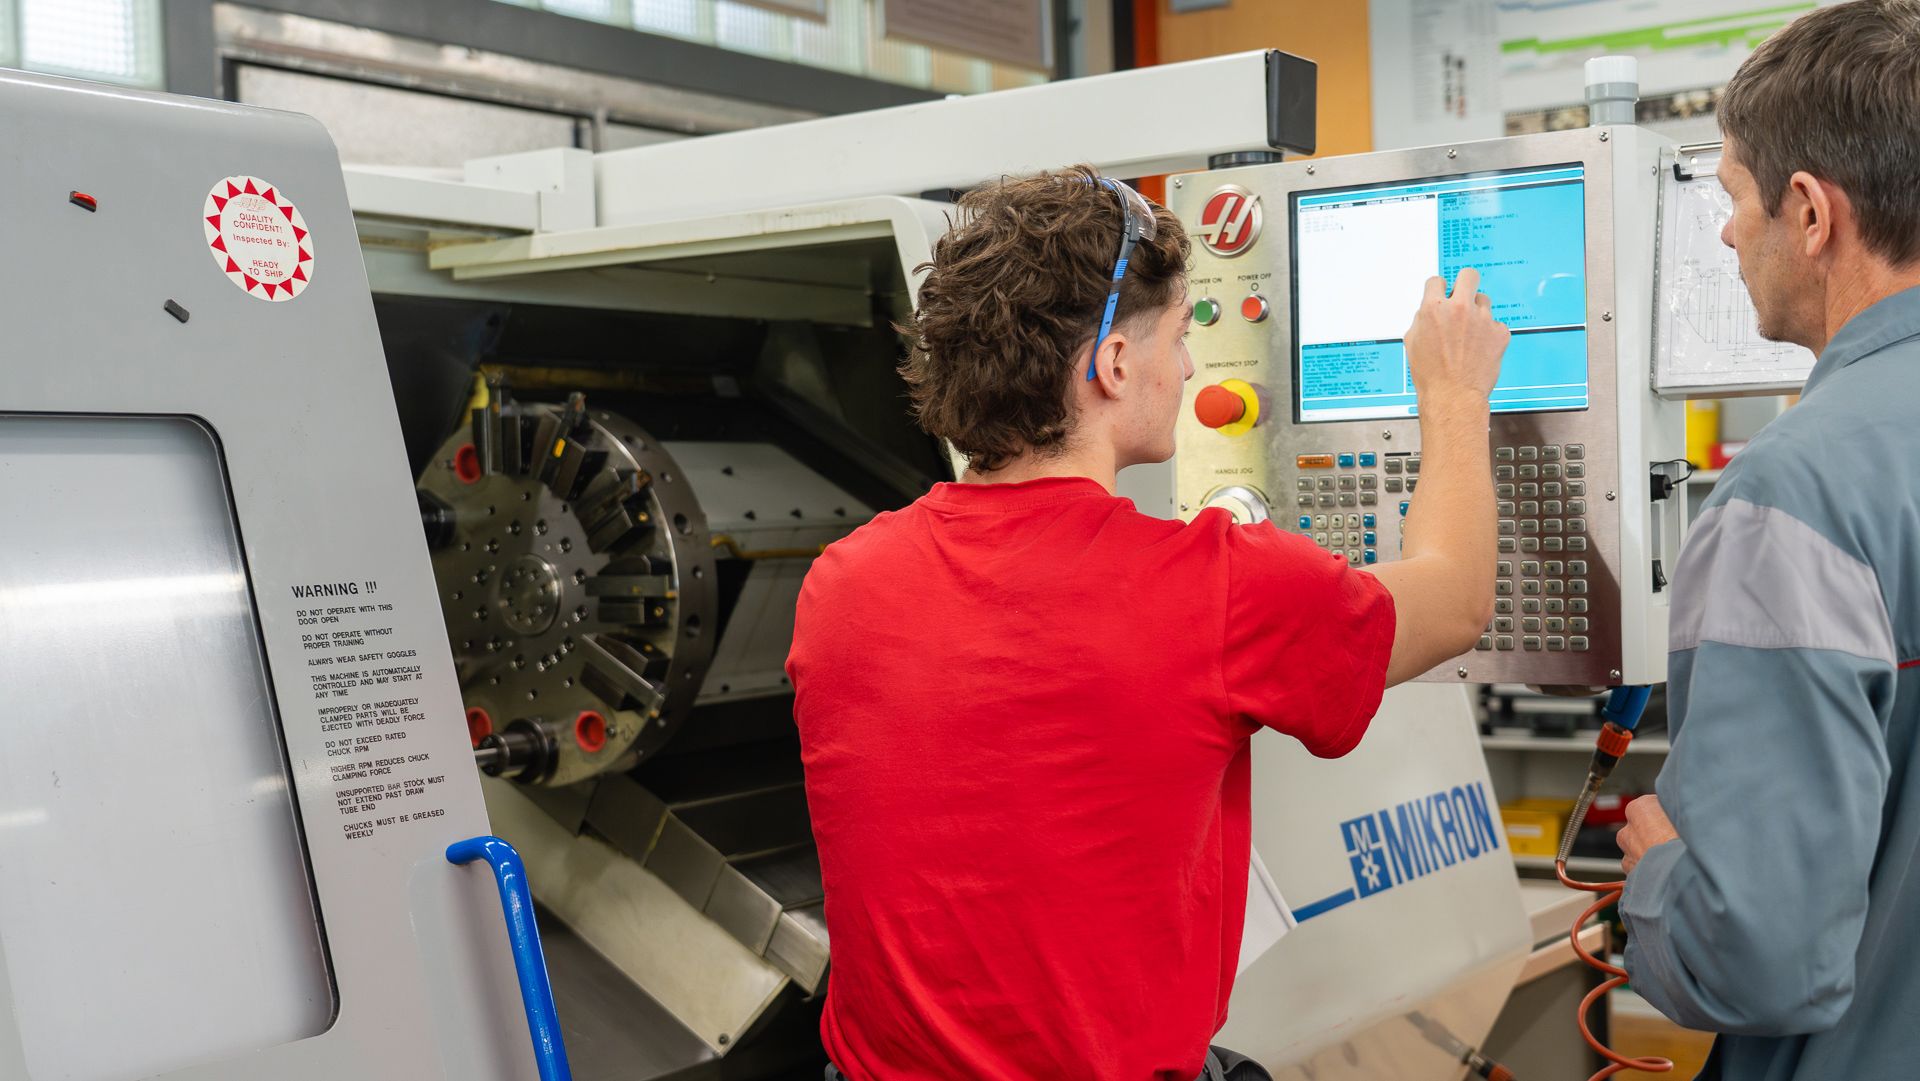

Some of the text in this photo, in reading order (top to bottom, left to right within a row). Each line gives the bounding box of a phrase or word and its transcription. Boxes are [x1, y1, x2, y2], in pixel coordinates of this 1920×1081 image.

[240, 213, 273, 223] QUALITY
[234, 221, 283, 233] CONFIDENT!
[233, 234, 273, 245] Inspected
[253, 260, 279, 269] READY
[249, 268, 260, 276] TO
[1206, 361, 1242, 369] EMERGENCY
[292, 581, 377, 598] WARNING !!!
[297, 610, 307, 618] DO
[327, 607, 356, 616] OPERATE
[359, 605, 376, 613] WITH
[298, 616, 339, 626] DOOR OPEN
[315, 633, 329, 641] NOT
[332, 631, 361, 640] OPERATE
[364, 628, 393, 637] WITHOUT
[304, 639, 365, 650] PROPER TRAINING
[308, 650, 417, 667] ALWAYS WEAR SAFETY GOGGLES
[311, 675, 327, 683] THIS
[330, 672, 359, 681] MACHINE
[372, 665, 422, 677] AUTOMATICALLY
[313, 680, 357, 691] CONTROLLED
[393, 674, 412, 682] START
[332, 689, 349, 697] TIME
[318, 705, 358, 716] IMPROPERLY
[375, 698, 419, 709] INADEQUATELY
[320, 714, 353, 724] CLAMPED
[356, 711, 378, 720] PARTS
[381, 709, 397, 717] WILL
[322, 713, 426, 732] EJECTED WITH DEADLY FORCE
[325, 732, 407, 749] DO NOT EXCEED RATED
[328, 748, 352, 757] CHUCK
[331, 754, 430, 773] HIGHER RPM REDUCES CHUCK
[333, 767, 392, 782] CLAMPING FORCE
[336, 776, 446, 799] UNSUPPORTED BAR STOCK MUST
[338, 788, 425, 807] NOT EXTEND PAST DRAW
[340, 804, 376, 815] TUBE END
[344, 809, 445, 832] CHUCKS MUST BE GREASED
[345, 829, 374, 840] WEEKLY
[1379, 781, 1500, 885] MIKRON
